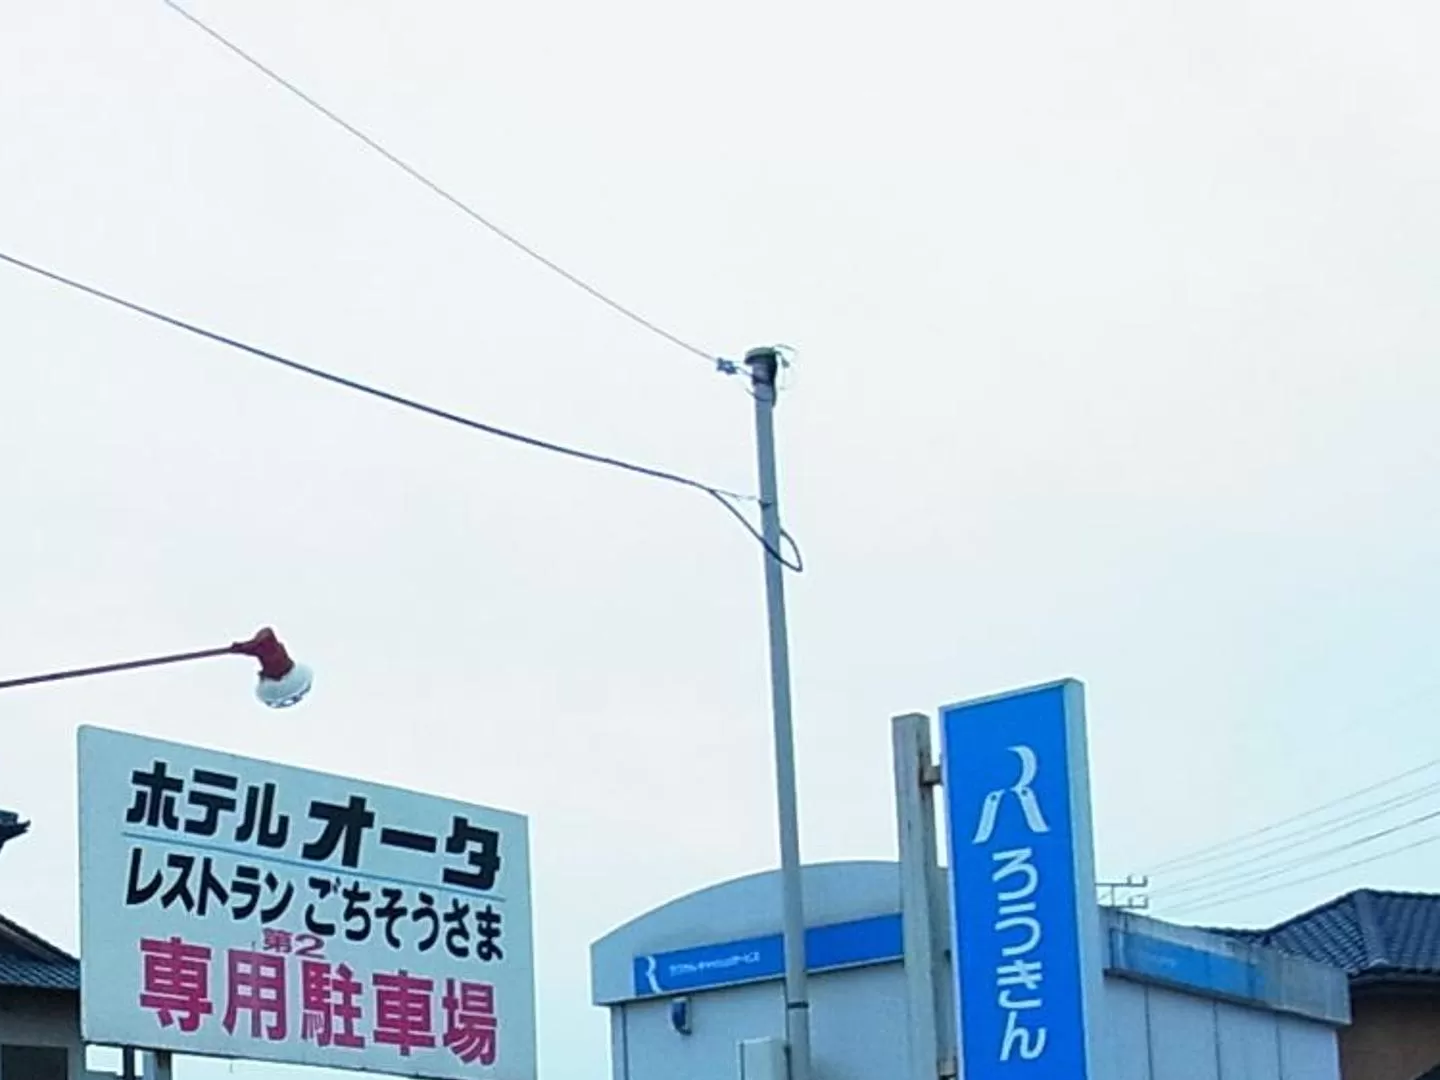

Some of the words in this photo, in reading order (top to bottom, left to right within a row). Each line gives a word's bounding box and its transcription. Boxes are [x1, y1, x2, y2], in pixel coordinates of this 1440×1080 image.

[138, 936, 498, 1067] 専用駐車場
[262, 927, 328, 960] 第2
[991, 847, 1048, 1061] ろうきん
